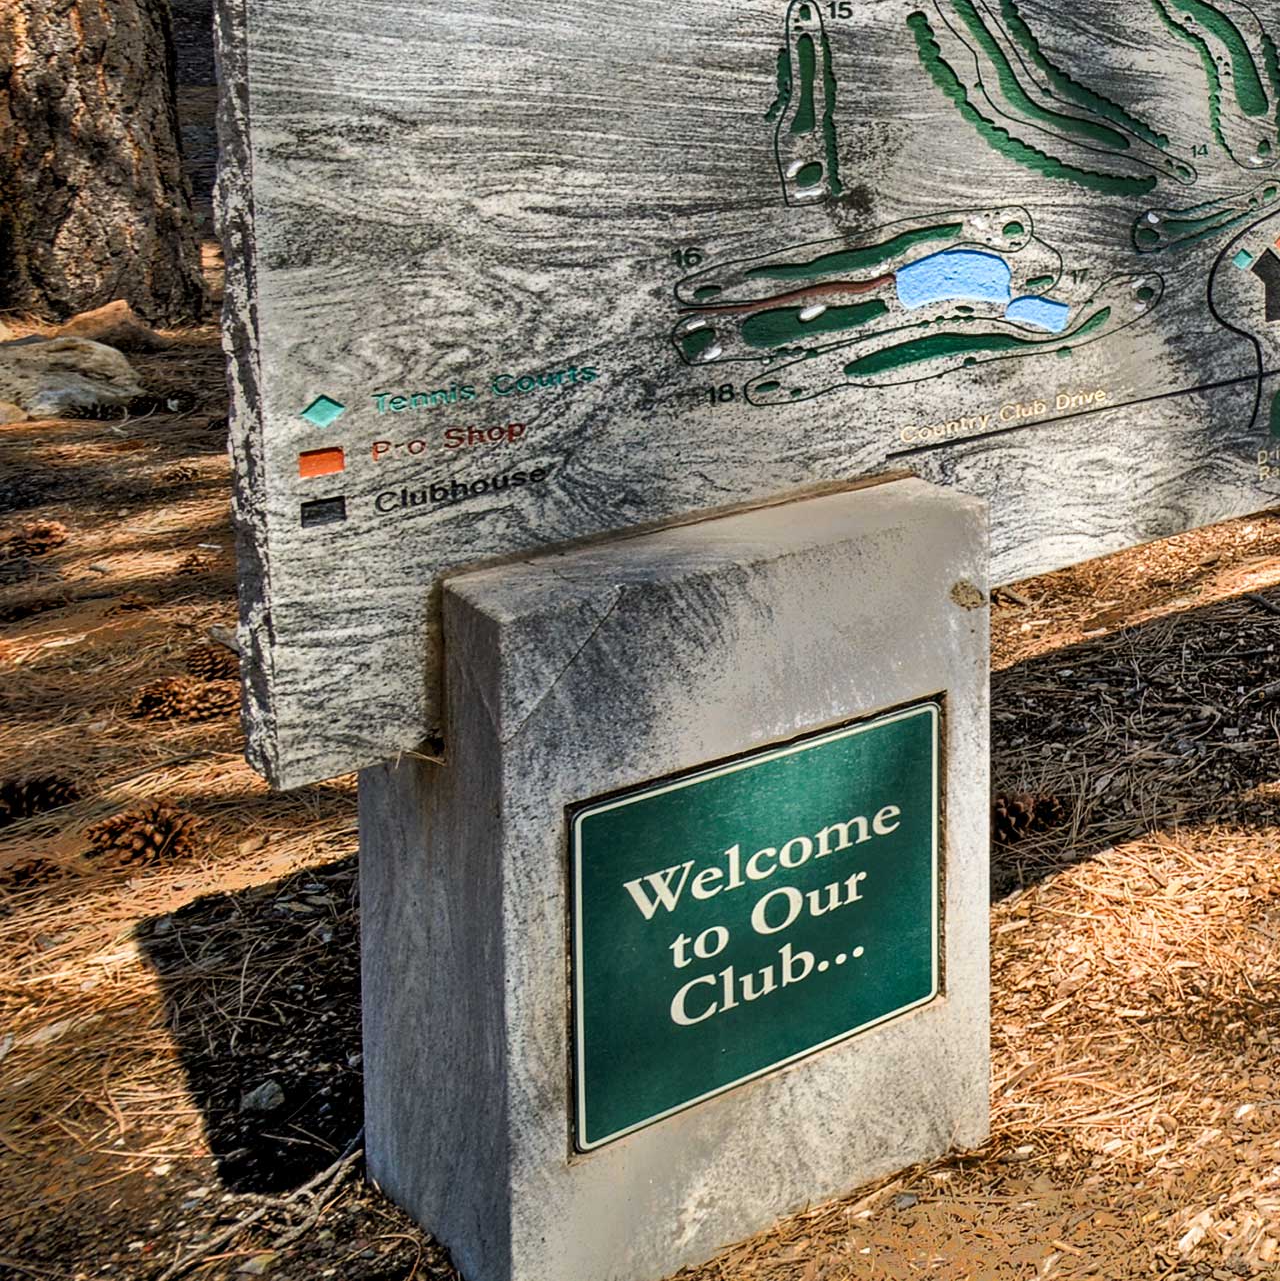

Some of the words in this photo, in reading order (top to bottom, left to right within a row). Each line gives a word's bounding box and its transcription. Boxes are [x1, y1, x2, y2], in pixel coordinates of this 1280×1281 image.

[826, 1, 853, 19] 15
[1190, 144, 1208, 158] 14
[672, 247, 702, 268] 16
[1072, 269, 1088, 284] 17
[372, 382, 476, 415] Tennis
[492, 365, 599, 396] Courts
[704, 383, 735, 403] 18
[900, 413, 990, 443] Country
[999, 399, 1047, 421] Club
[1055, 388, 1107, 411] Drive
[444, 423, 527, 449] Shop
[375, 468, 550, 513] Clubhouse
[623, 805, 901, 920] Welcome
[669, 925, 729, 969] to
[751, 871, 867, 936] Our
[670, 942, 865, 1026] Club...
